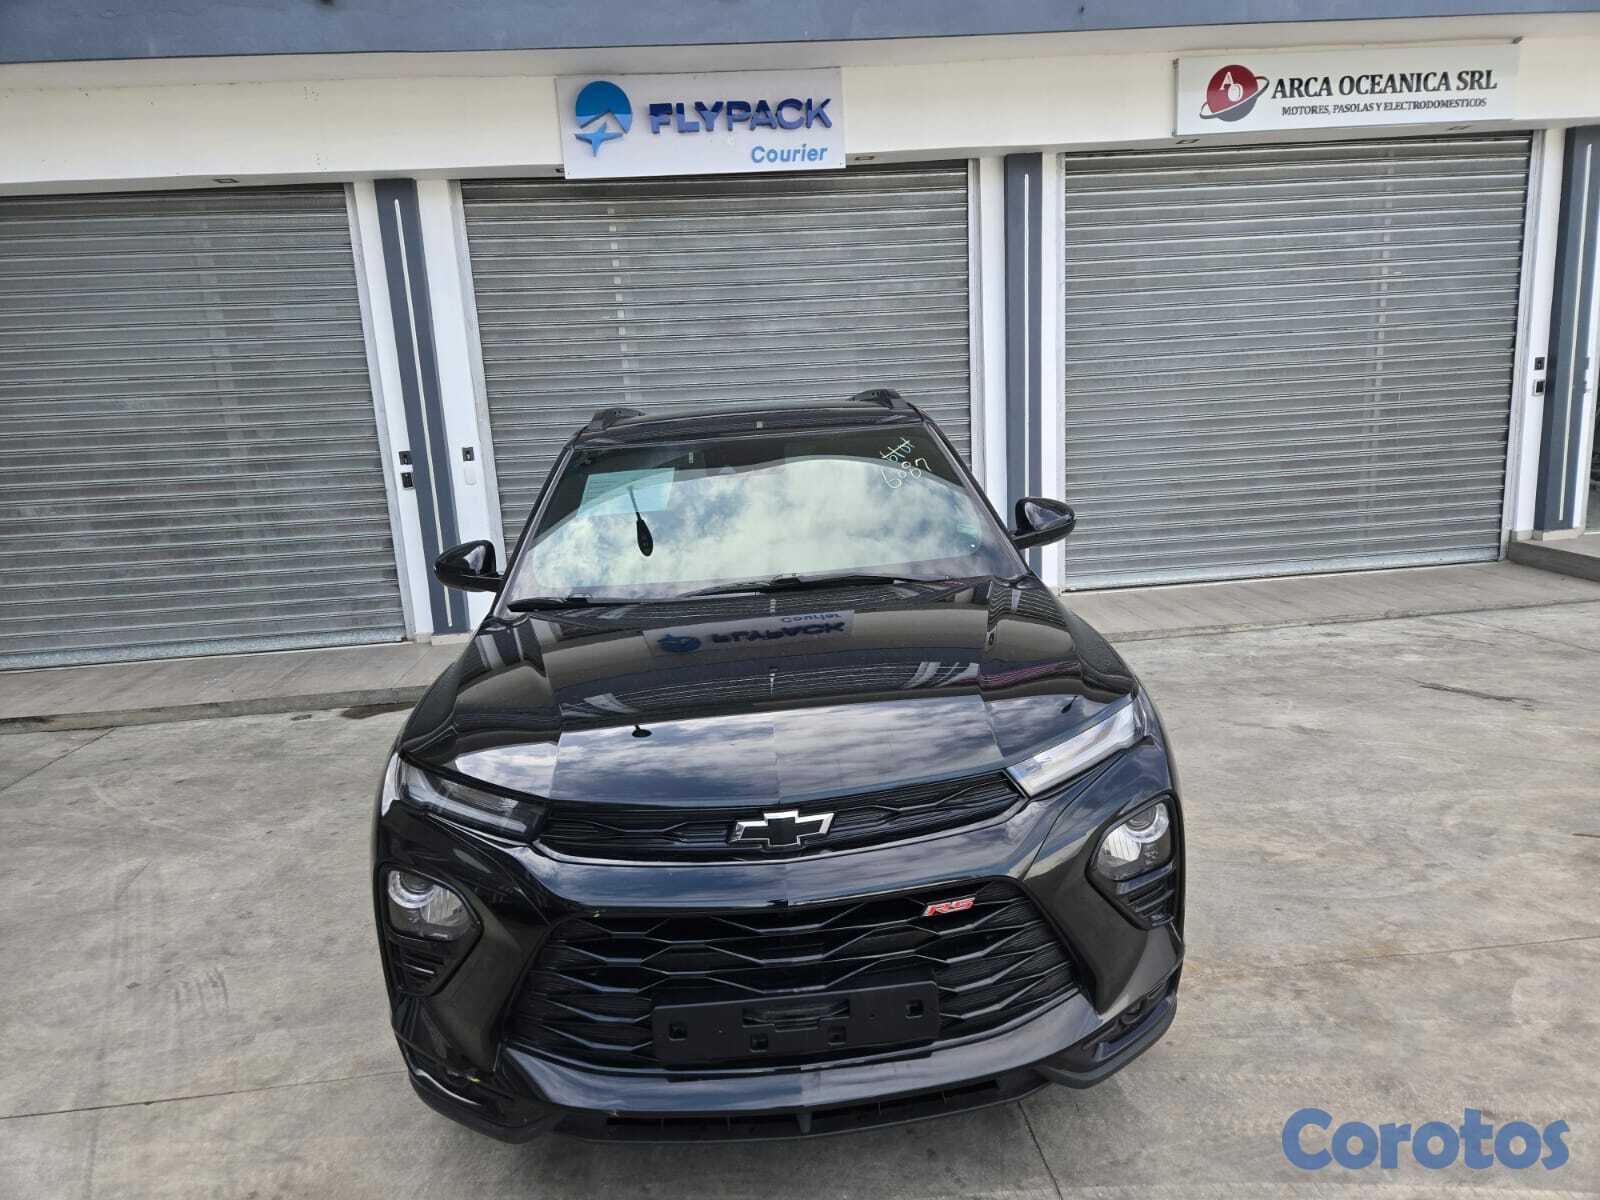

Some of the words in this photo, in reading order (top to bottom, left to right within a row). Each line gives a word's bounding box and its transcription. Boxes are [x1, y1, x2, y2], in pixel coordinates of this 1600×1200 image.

[1271, 76, 1334, 99] ARCA
[1338, 71, 1452, 95] OCEANICA
[1455, 69, 1498, 91] SRL
[649, 97, 833, 135] FLYPACK
[1281, 104, 1332, 116] MOTORES,
[1333, 101, 1375, 114] PASOLAS
[1375, 101, 1383, 112] Y
[1383, 97, 1488, 111] ELECTRODOMESTICOS
[751, 143, 829, 163] Courier
[922, 896, 976, 917] RS
